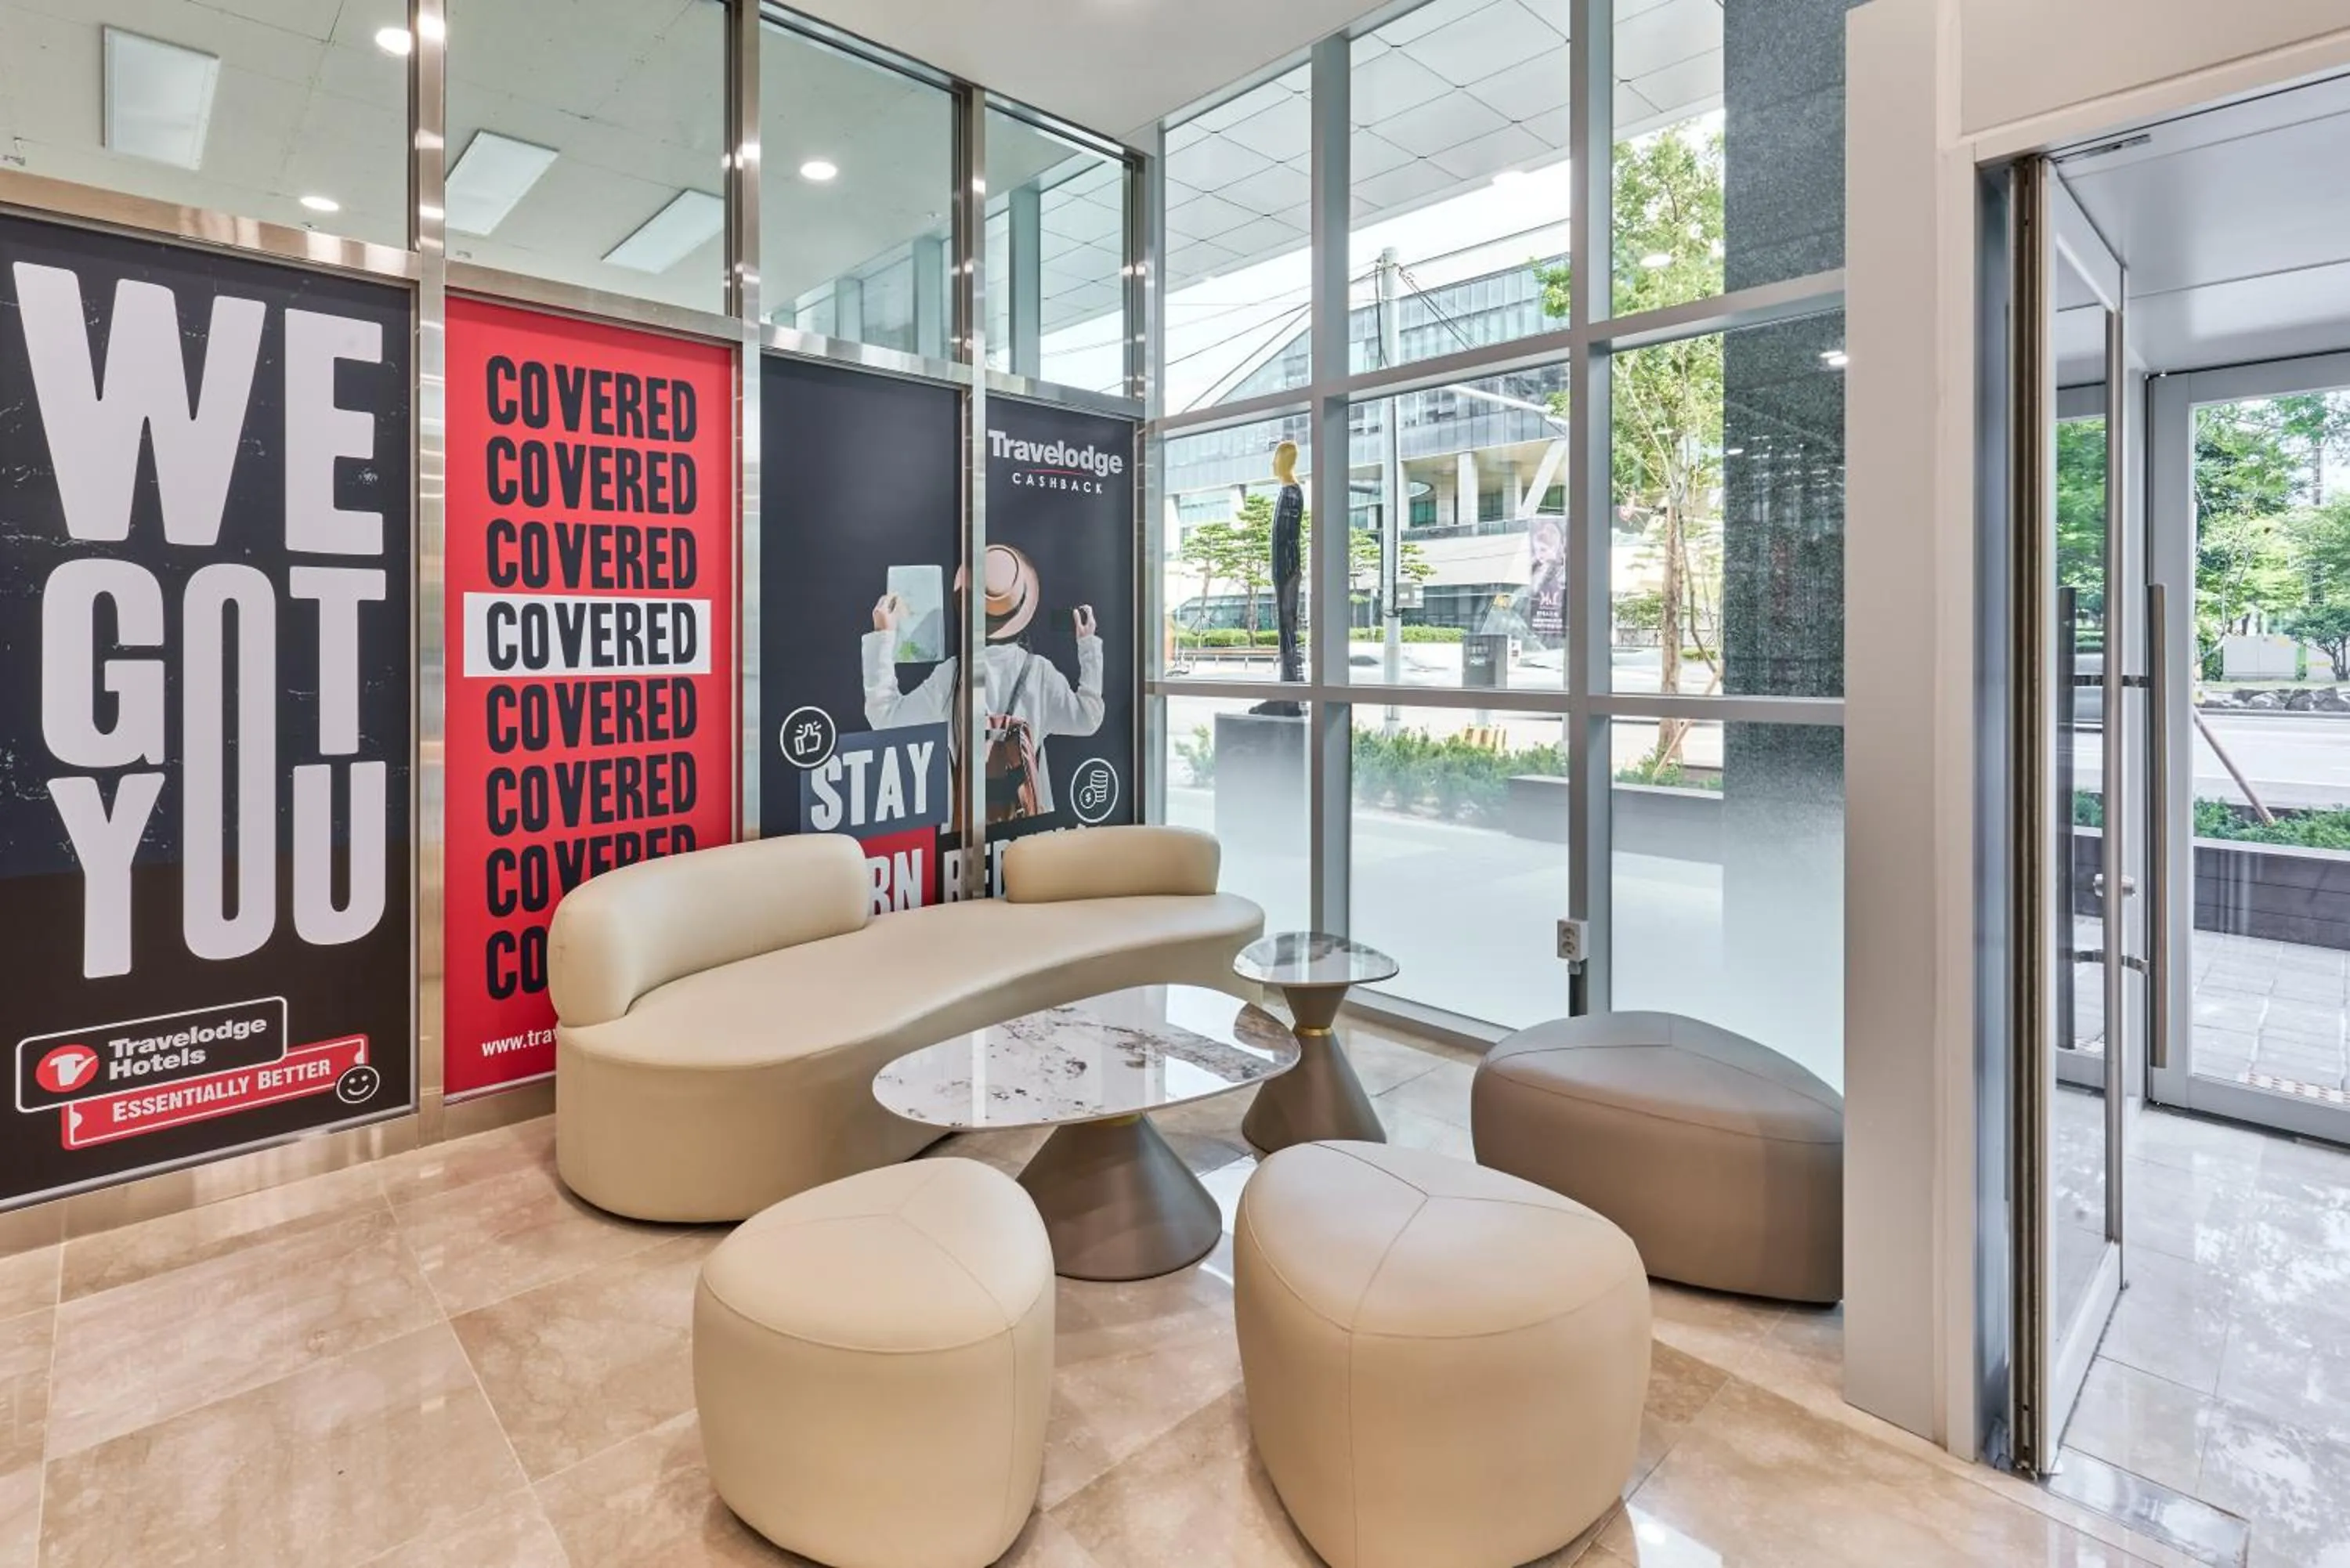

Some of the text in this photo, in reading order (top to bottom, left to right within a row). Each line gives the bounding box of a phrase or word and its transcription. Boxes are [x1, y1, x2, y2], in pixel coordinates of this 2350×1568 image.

[13, 262, 384, 555] WE
[487, 356, 696, 443] COVERED
[487, 436, 696, 515] COVERED
[988, 429, 1123, 477] Travelodge
[1011, 472, 1103, 494] CASHBACK
[487, 518, 696, 590] COVERED
[42, 558, 386, 771] GOT
[487, 602, 696, 671] COVERED
[487, 677, 696, 753] COVERED
[487, 752, 696, 836] COVERED
[811, 740, 935, 832] STAY
[47, 761, 386, 979] YOU
[865, 848, 924, 916] RN
[109, 1018, 267, 1058] Travelodge
[109, 1047, 206, 1080] Hotels
[112, 1059, 331, 1123] ESSENTIALLY BETTER
